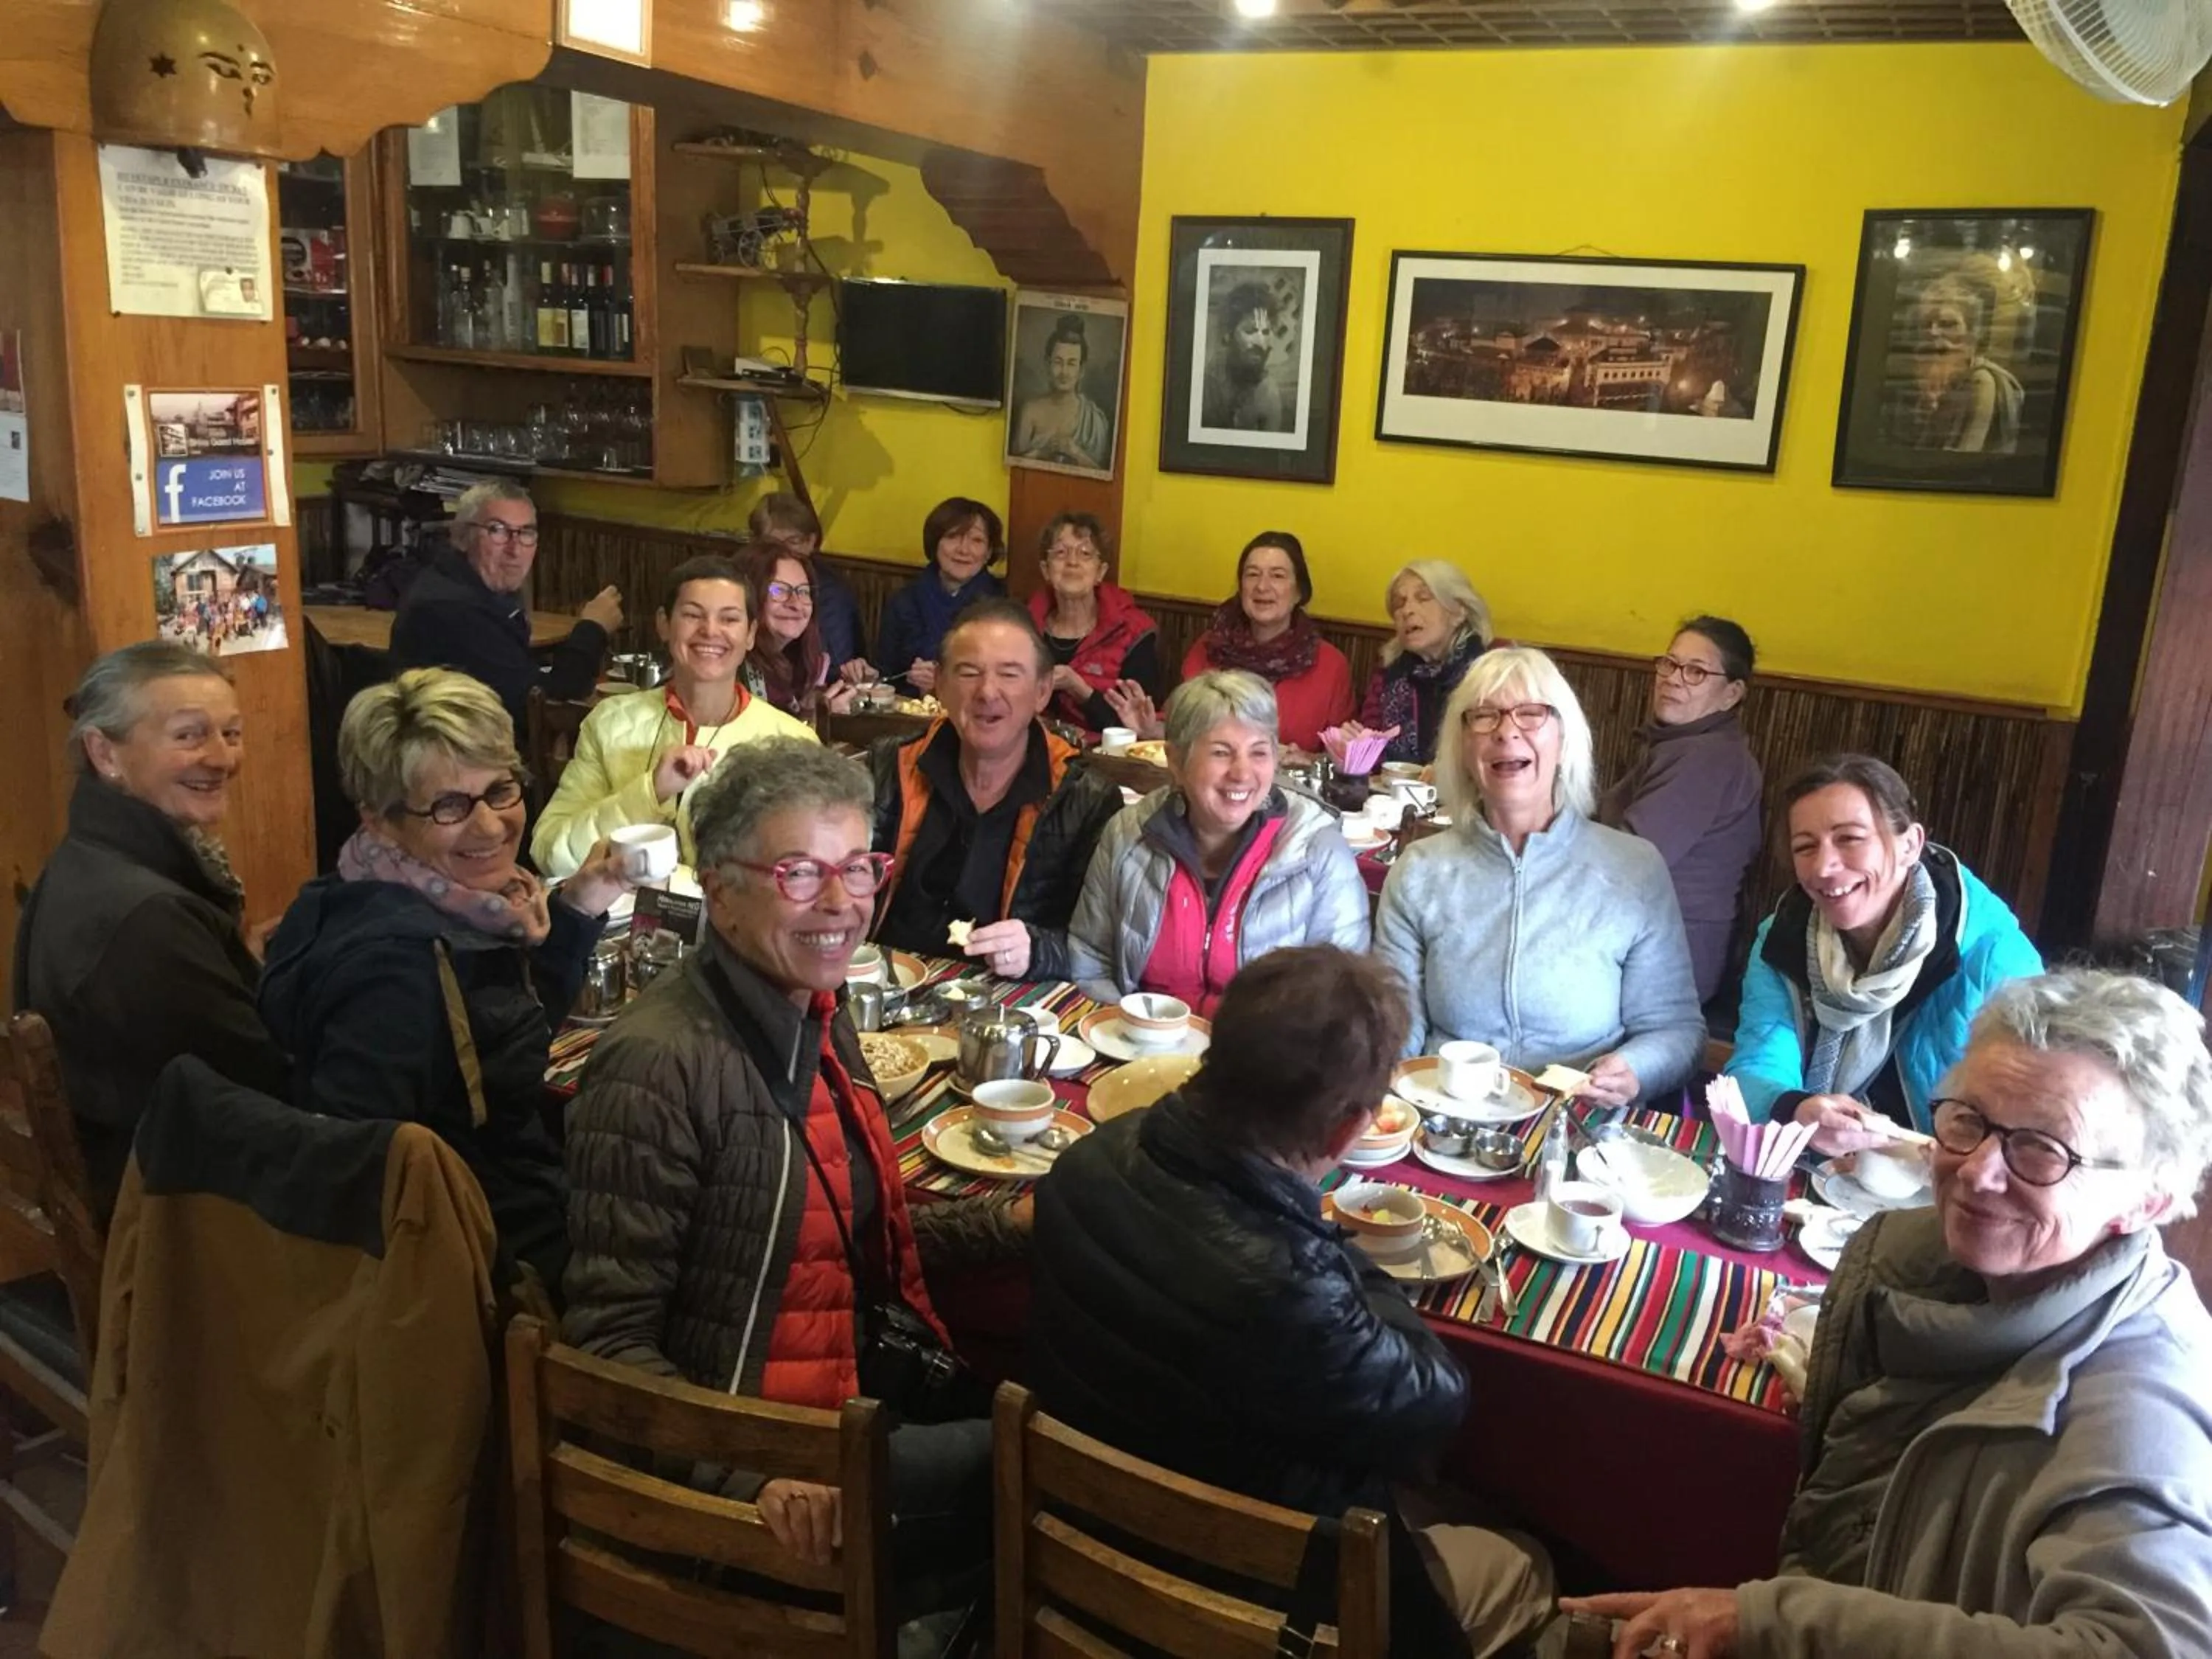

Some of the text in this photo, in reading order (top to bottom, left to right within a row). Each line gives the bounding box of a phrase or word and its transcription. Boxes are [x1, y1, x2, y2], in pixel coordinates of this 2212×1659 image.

[209, 468, 246, 480] JOIN US
[234, 481, 246, 492] AT
[191, 495, 246, 508] FACEBOOK
